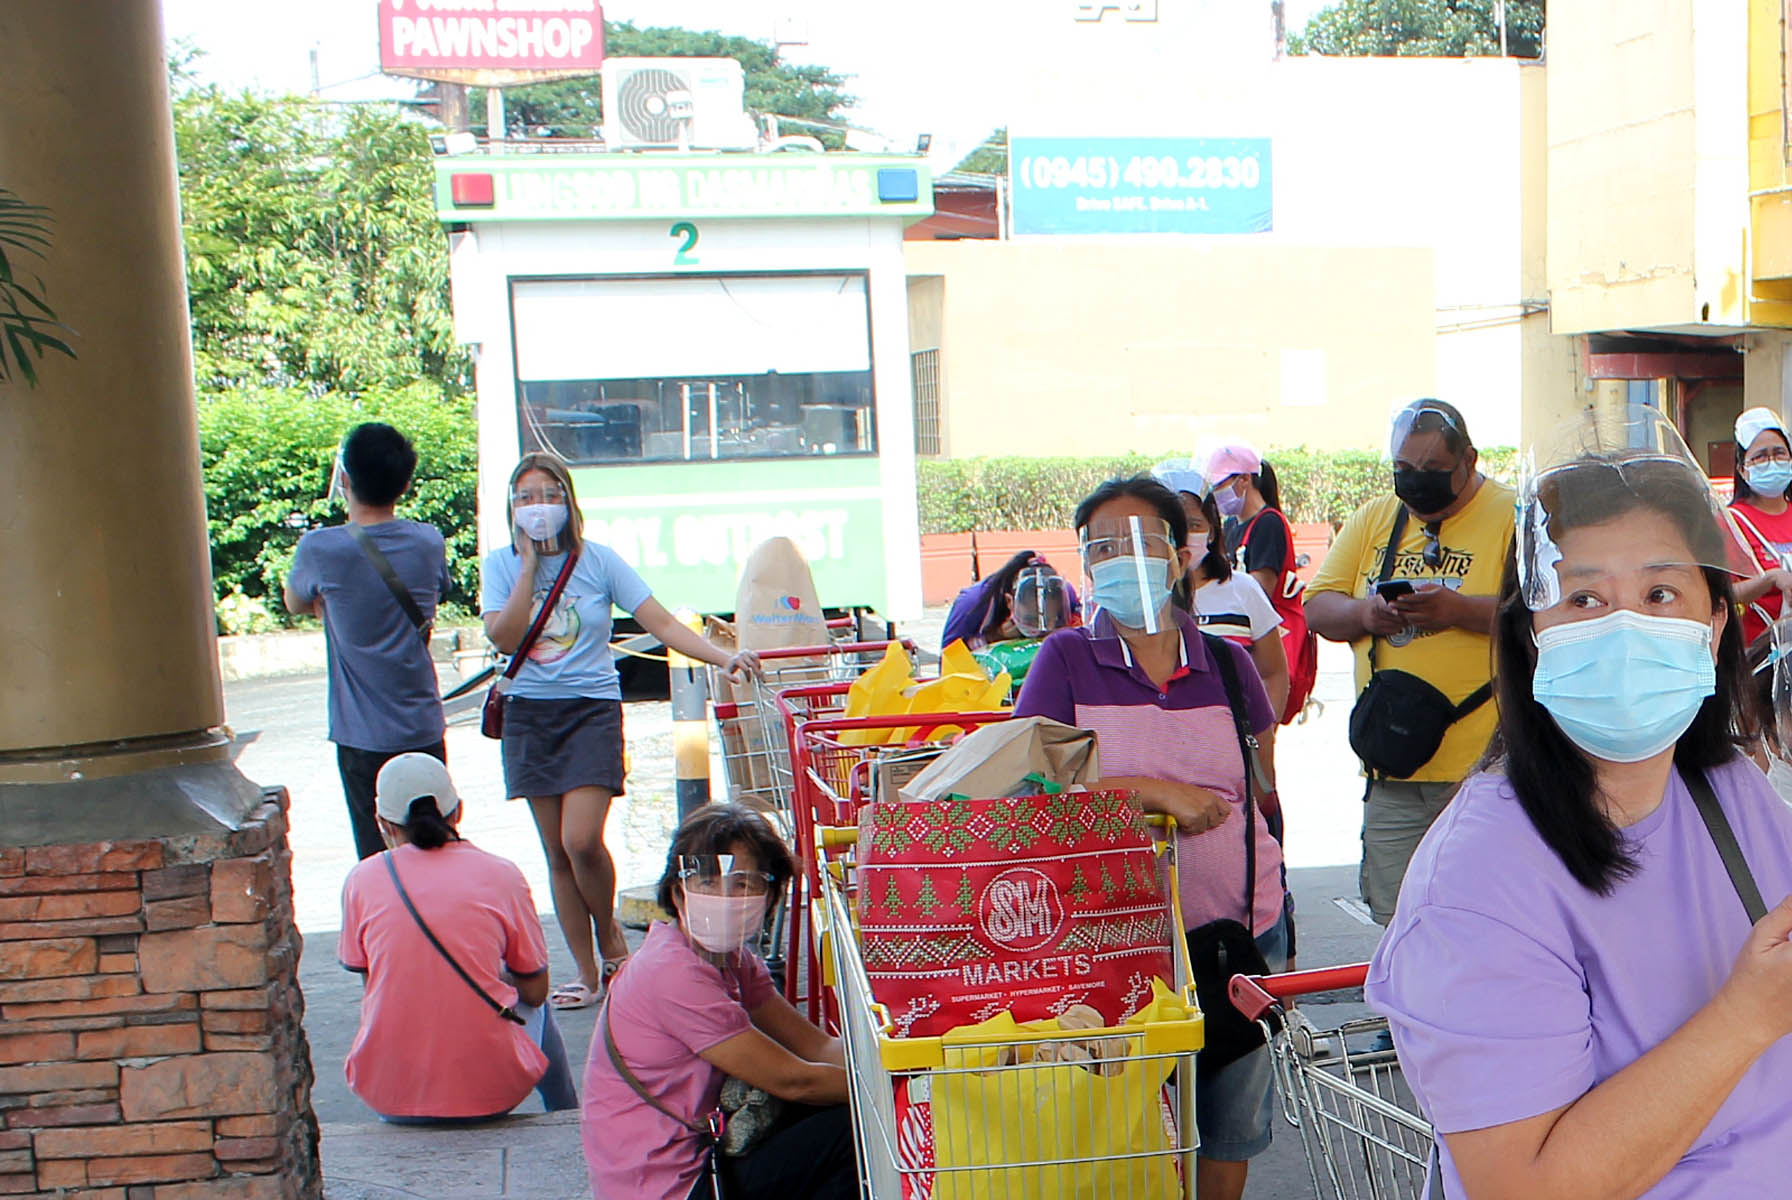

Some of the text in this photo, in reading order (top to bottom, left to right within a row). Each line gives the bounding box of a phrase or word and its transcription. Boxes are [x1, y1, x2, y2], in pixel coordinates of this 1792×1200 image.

[391, 16, 593, 58] PAWNSHOP
[1020, 154, 1260, 190] (0945) 490.2830
[669, 222, 700, 265] 2
[988, 880, 1052, 942] SM
[962, 953, 1091, 987] MARKETS
